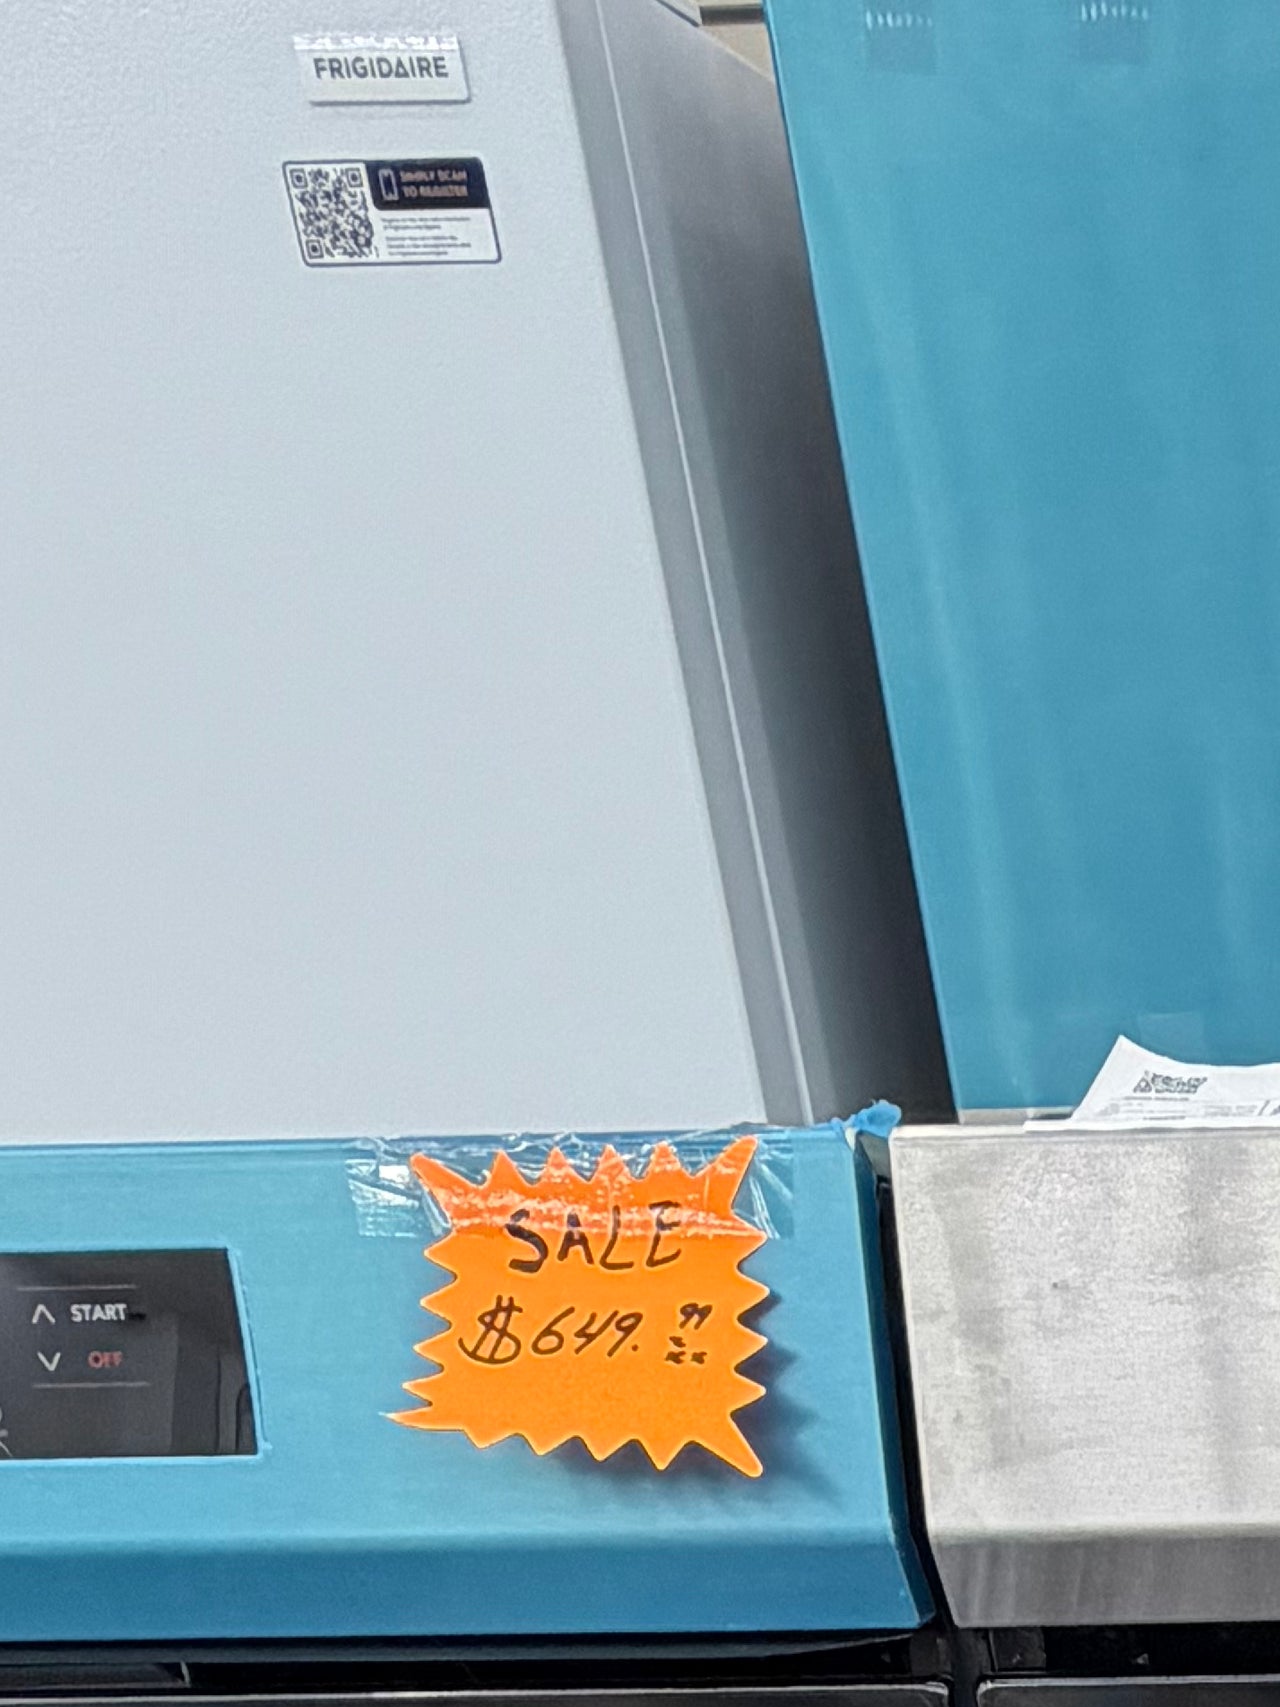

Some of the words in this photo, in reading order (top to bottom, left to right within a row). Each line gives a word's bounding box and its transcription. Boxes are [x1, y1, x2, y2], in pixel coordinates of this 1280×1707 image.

[313, 56, 449, 79] FRIGIDAIRE
[402, 185, 418, 197] TO
[504, 1200, 682, 1273] SALE
[69, 1303, 128, 1322] START
[87, 1351, 124, 1369] OFF
